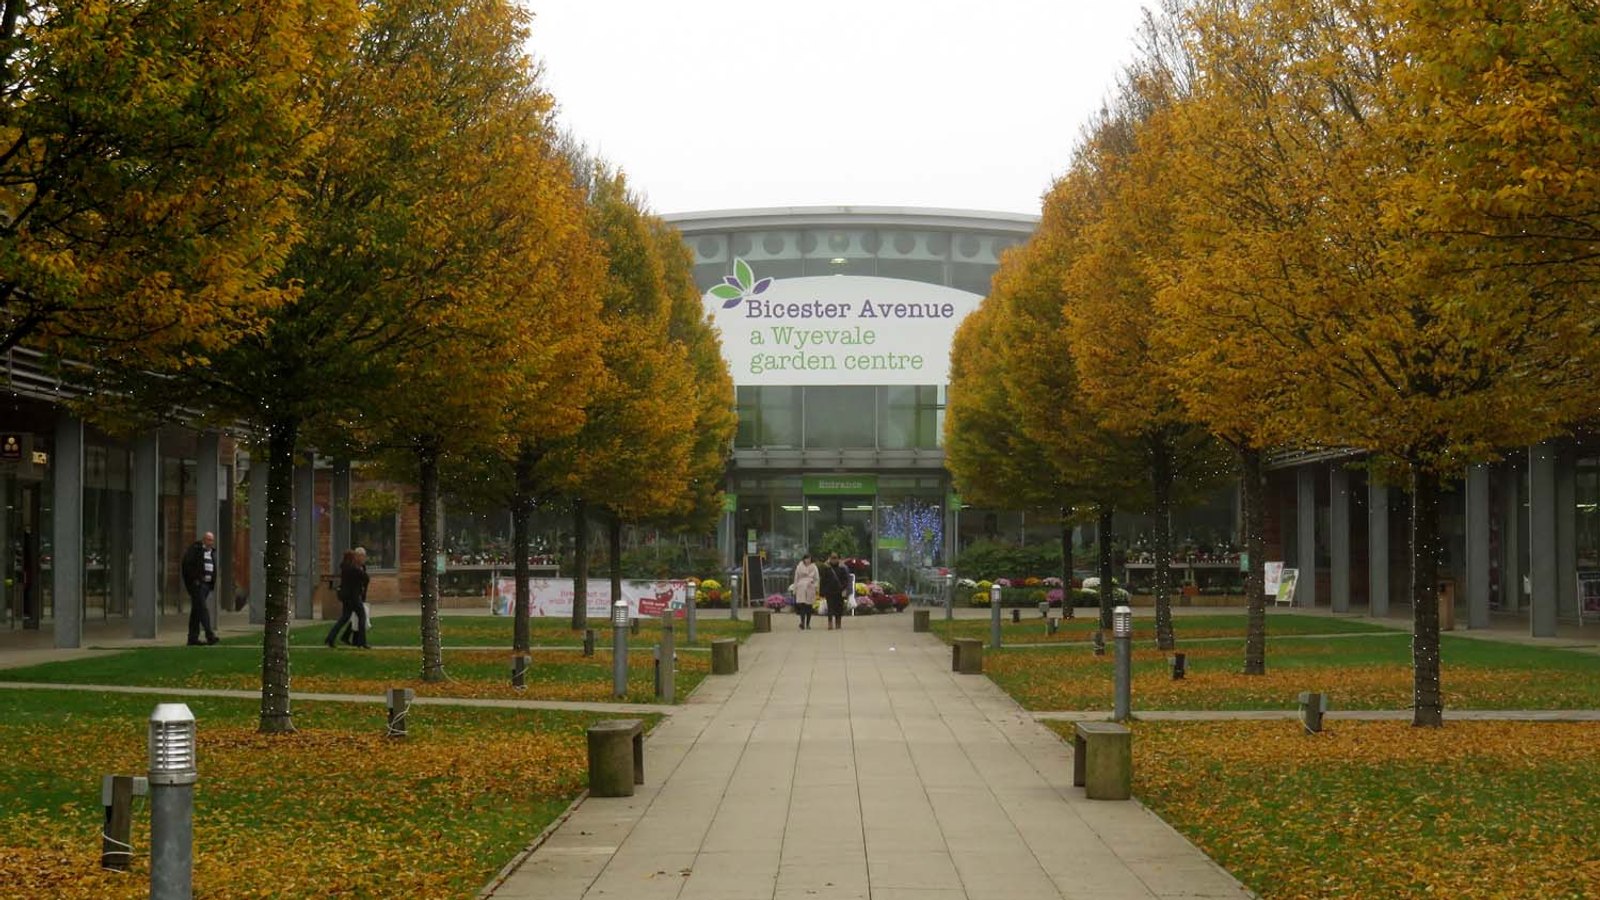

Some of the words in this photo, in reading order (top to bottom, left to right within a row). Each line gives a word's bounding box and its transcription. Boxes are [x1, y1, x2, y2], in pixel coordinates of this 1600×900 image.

[745, 299, 852, 318] Bicester
[858, 299, 955, 318] Avenue
[750, 329, 764, 345] a
[770, 326, 876, 349] Wyevale
[750, 351, 836, 374] garden
[844, 354, 924, 370] centre
[819, 479, 863, 489] Entrance
